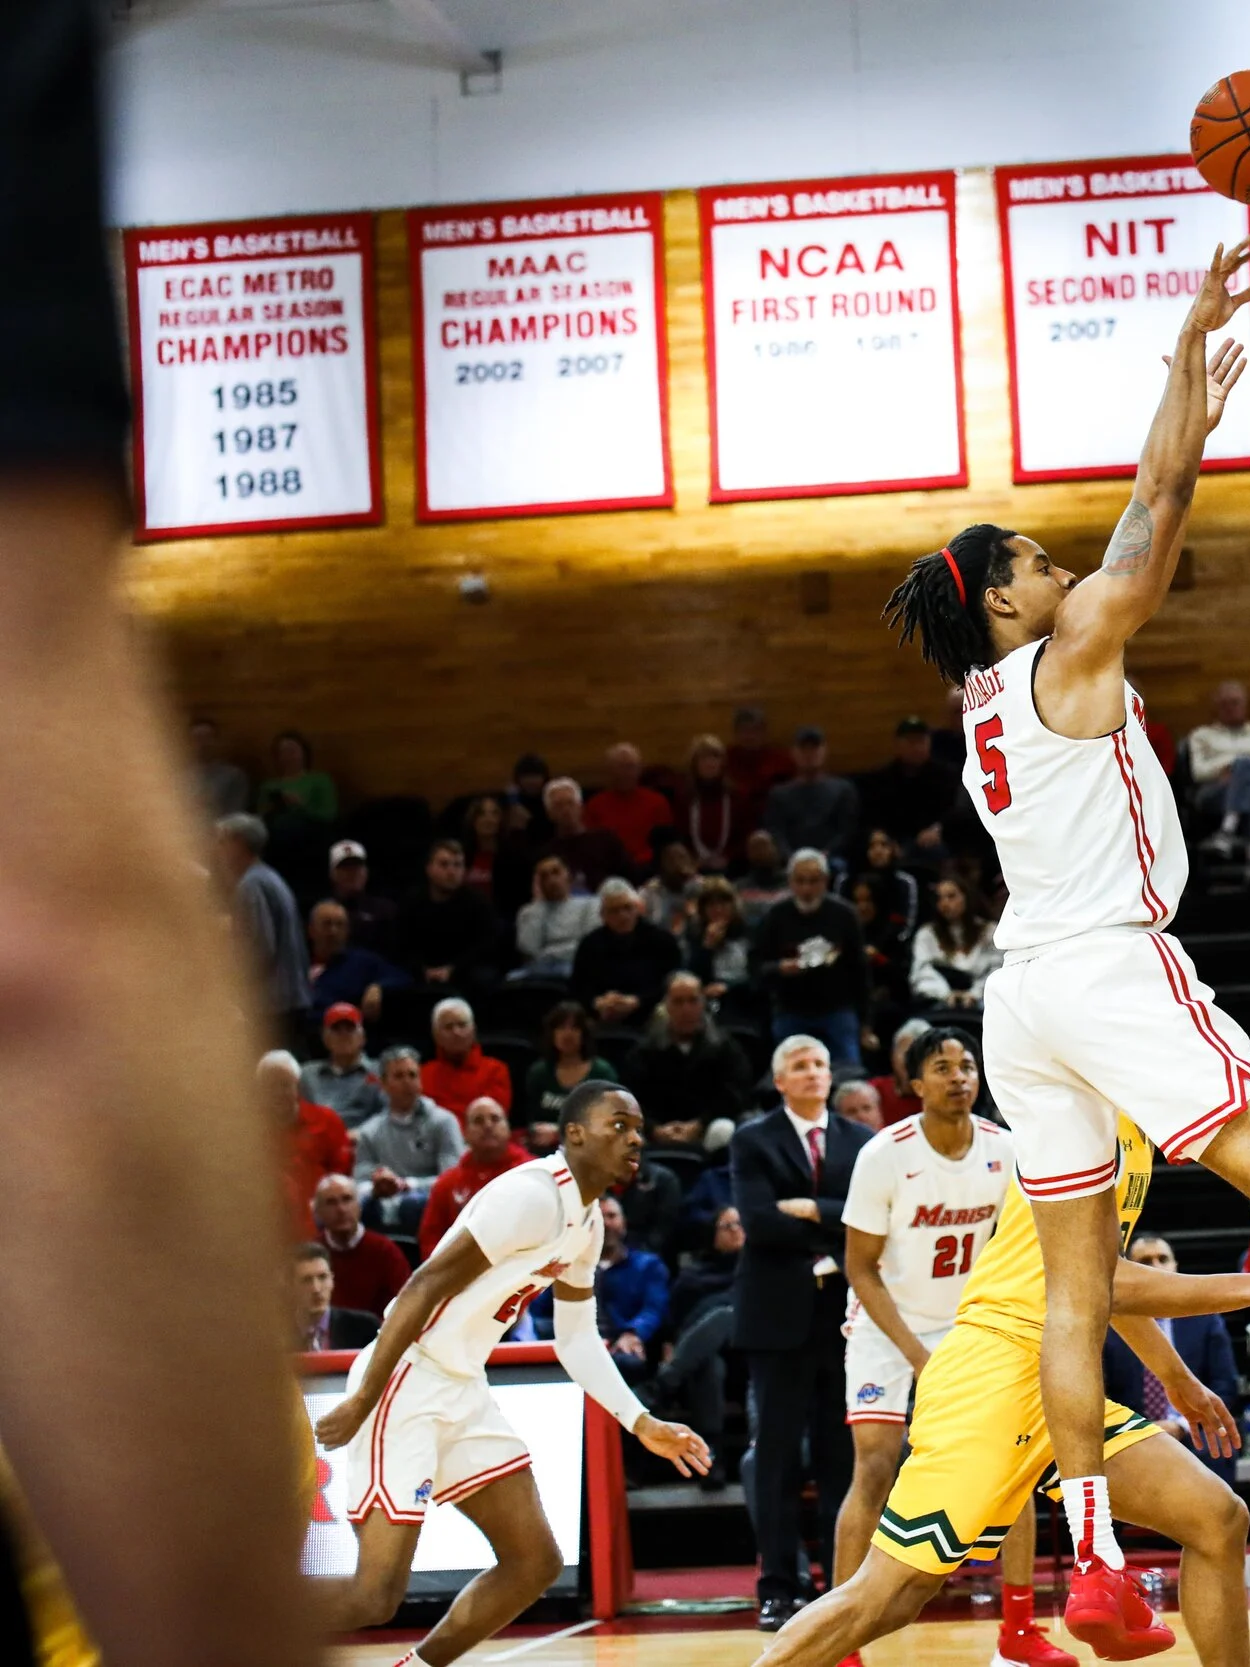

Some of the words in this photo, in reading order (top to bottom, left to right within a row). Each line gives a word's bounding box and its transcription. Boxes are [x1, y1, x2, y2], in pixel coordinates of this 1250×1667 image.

[1009, 175, 1086, 200] MEN'S
[1090, 166, 1208, 195] BASKETB
[713, 195, 789, 220] MEN'S
[794, 185, 946, 215] BASKETBALL
[422, 218, 496, 242] MEN'S
[502, 207, 650, 235] BASKETBALL
[1085, 218, 1175, 258] NIT
[139, 237, 208, 262] MEN'S
[214, 227, 359, 258] BASKETBALL
[760, 241, 904, 280] NCAA
[488, 252, 586, 278] MAAC
[165, 275, 231, 300] ECAC
[244, 268, 334, 295] METRO
[443, 287, 541, 309] REGULAR
[552, 279, 633, 301] SEASON
[1027, 273, 1135, 305] SECOND
[1147, 270, 1238, 297] ROUD
[159, 305, 254, 328] REGULAR
[263, 299, 344, 321] SEASON
[733, 294, 817, 324] FIRST
[832, 287, 937, 318] ROUND
[441, 308, 638, 349] CHAMPIONS
[1049, 318, 1117, 342] 2007
[157, 327, 349, 366] CHAMPIONS
[456, 361, 523, 385] 2002
[558, 353, 624, 377] 2007
[212, 379, 298, 411] 1985
[214, 424, 298, 454] 1987
[216, 468, 303, 499] 1988
[974, 713, 1012, 816] 5
[931, 1232, 975, 1279] 21
